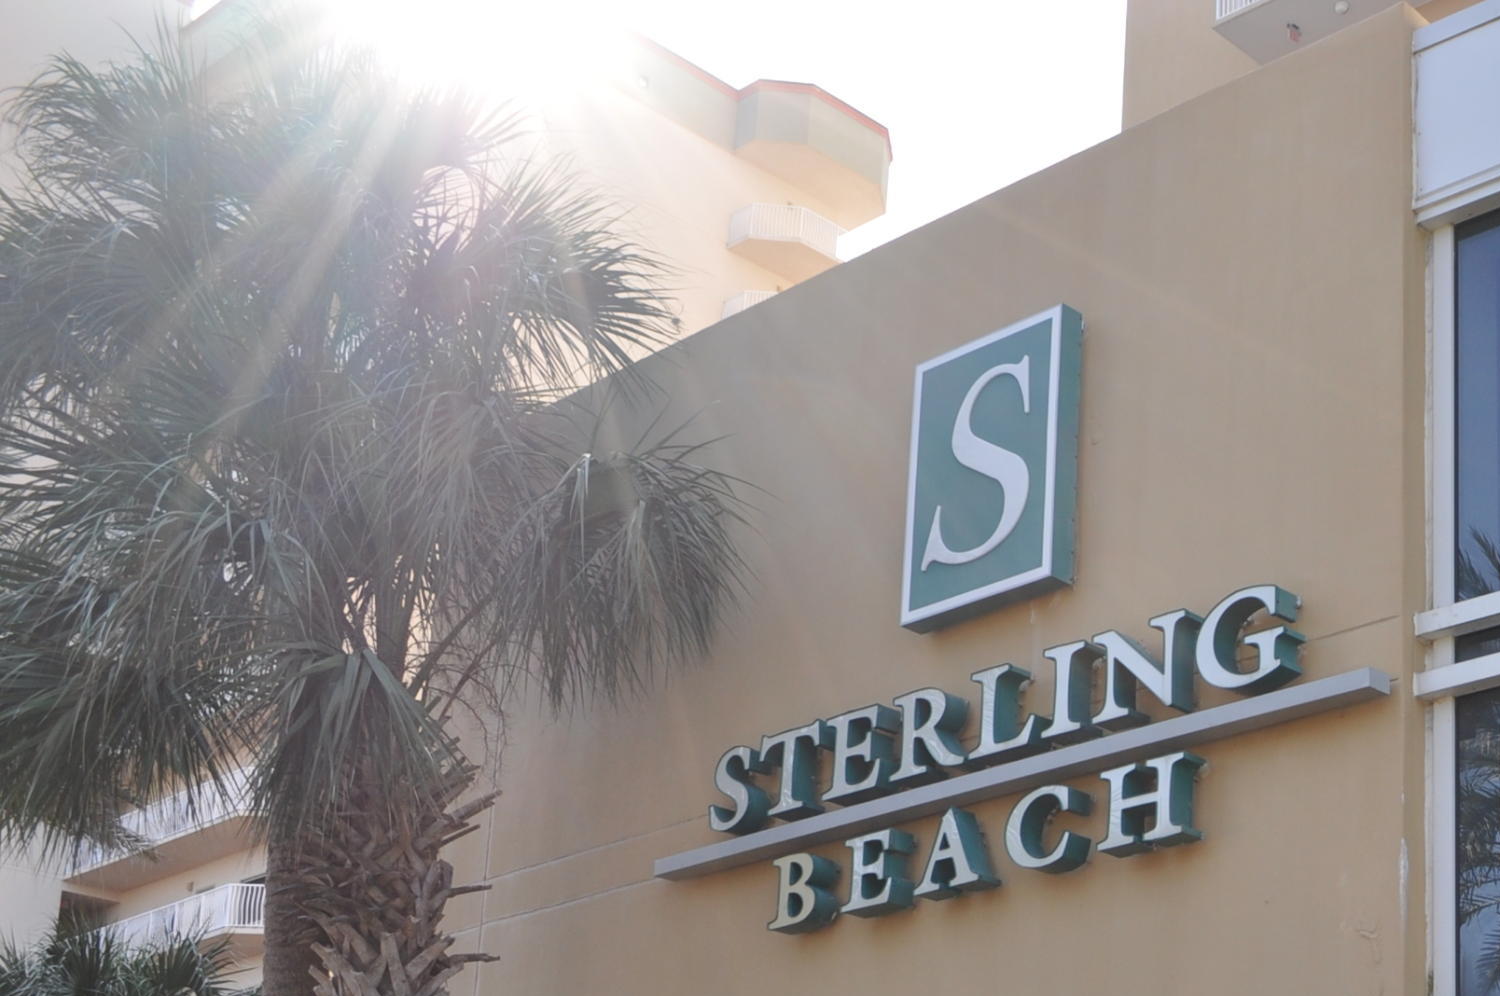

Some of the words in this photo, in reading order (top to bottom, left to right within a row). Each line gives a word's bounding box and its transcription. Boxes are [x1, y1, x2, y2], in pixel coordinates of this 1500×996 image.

[921, 354, 1030, 572] S
[709, 584, 1304, 835] STERLING
[767, 751, 1204, 933] BEACH
